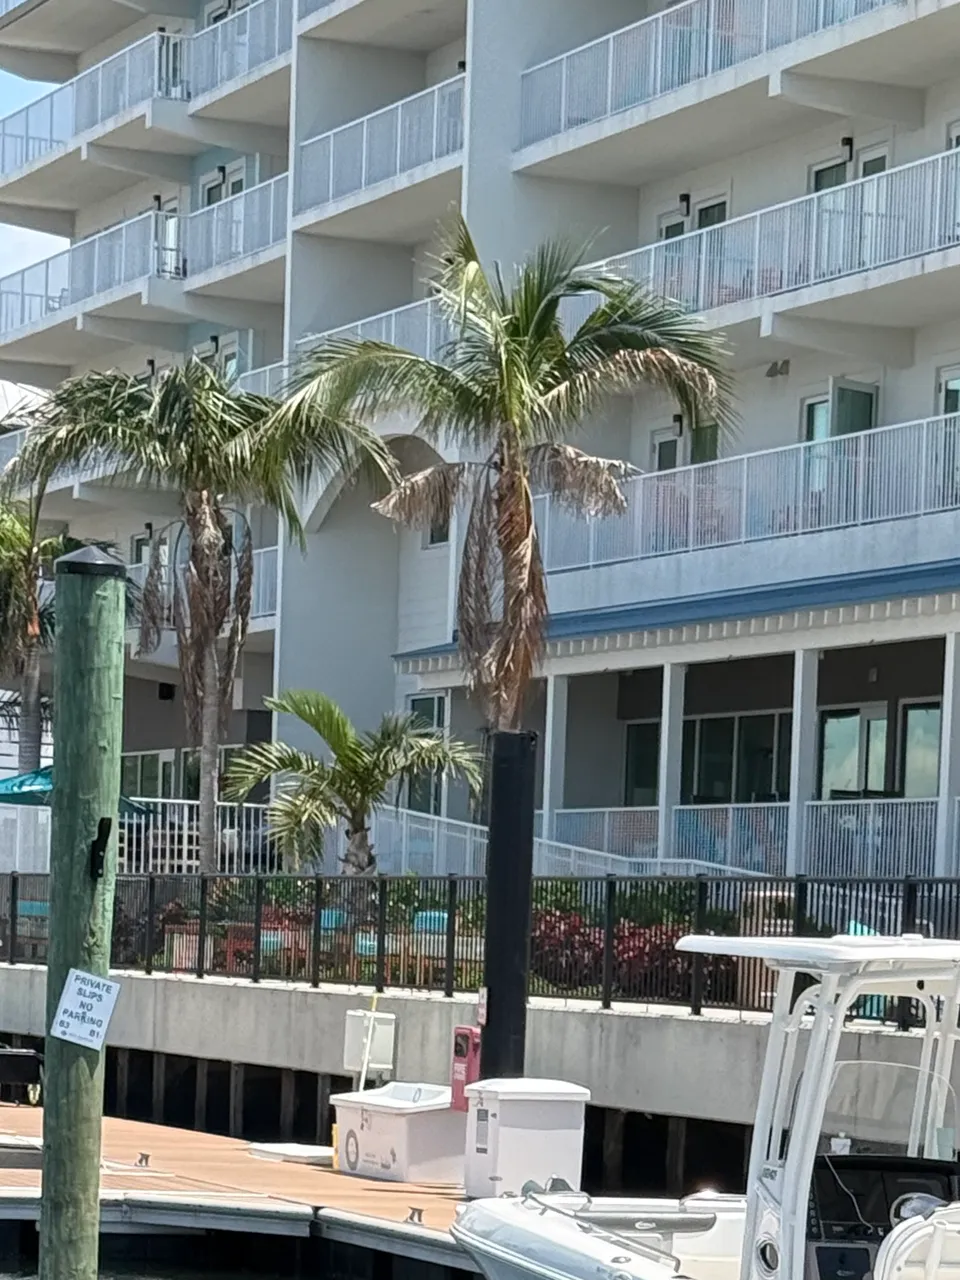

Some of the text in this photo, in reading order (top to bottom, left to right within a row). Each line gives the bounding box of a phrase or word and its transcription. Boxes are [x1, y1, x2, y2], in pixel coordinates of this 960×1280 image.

[75, 975, 112, 994] PRIVATE
[77, 987, 103, 1002] SLIPS
[79, 1001, 94, 1012] NO
[62, 1008, 103, 1028] PARKING
